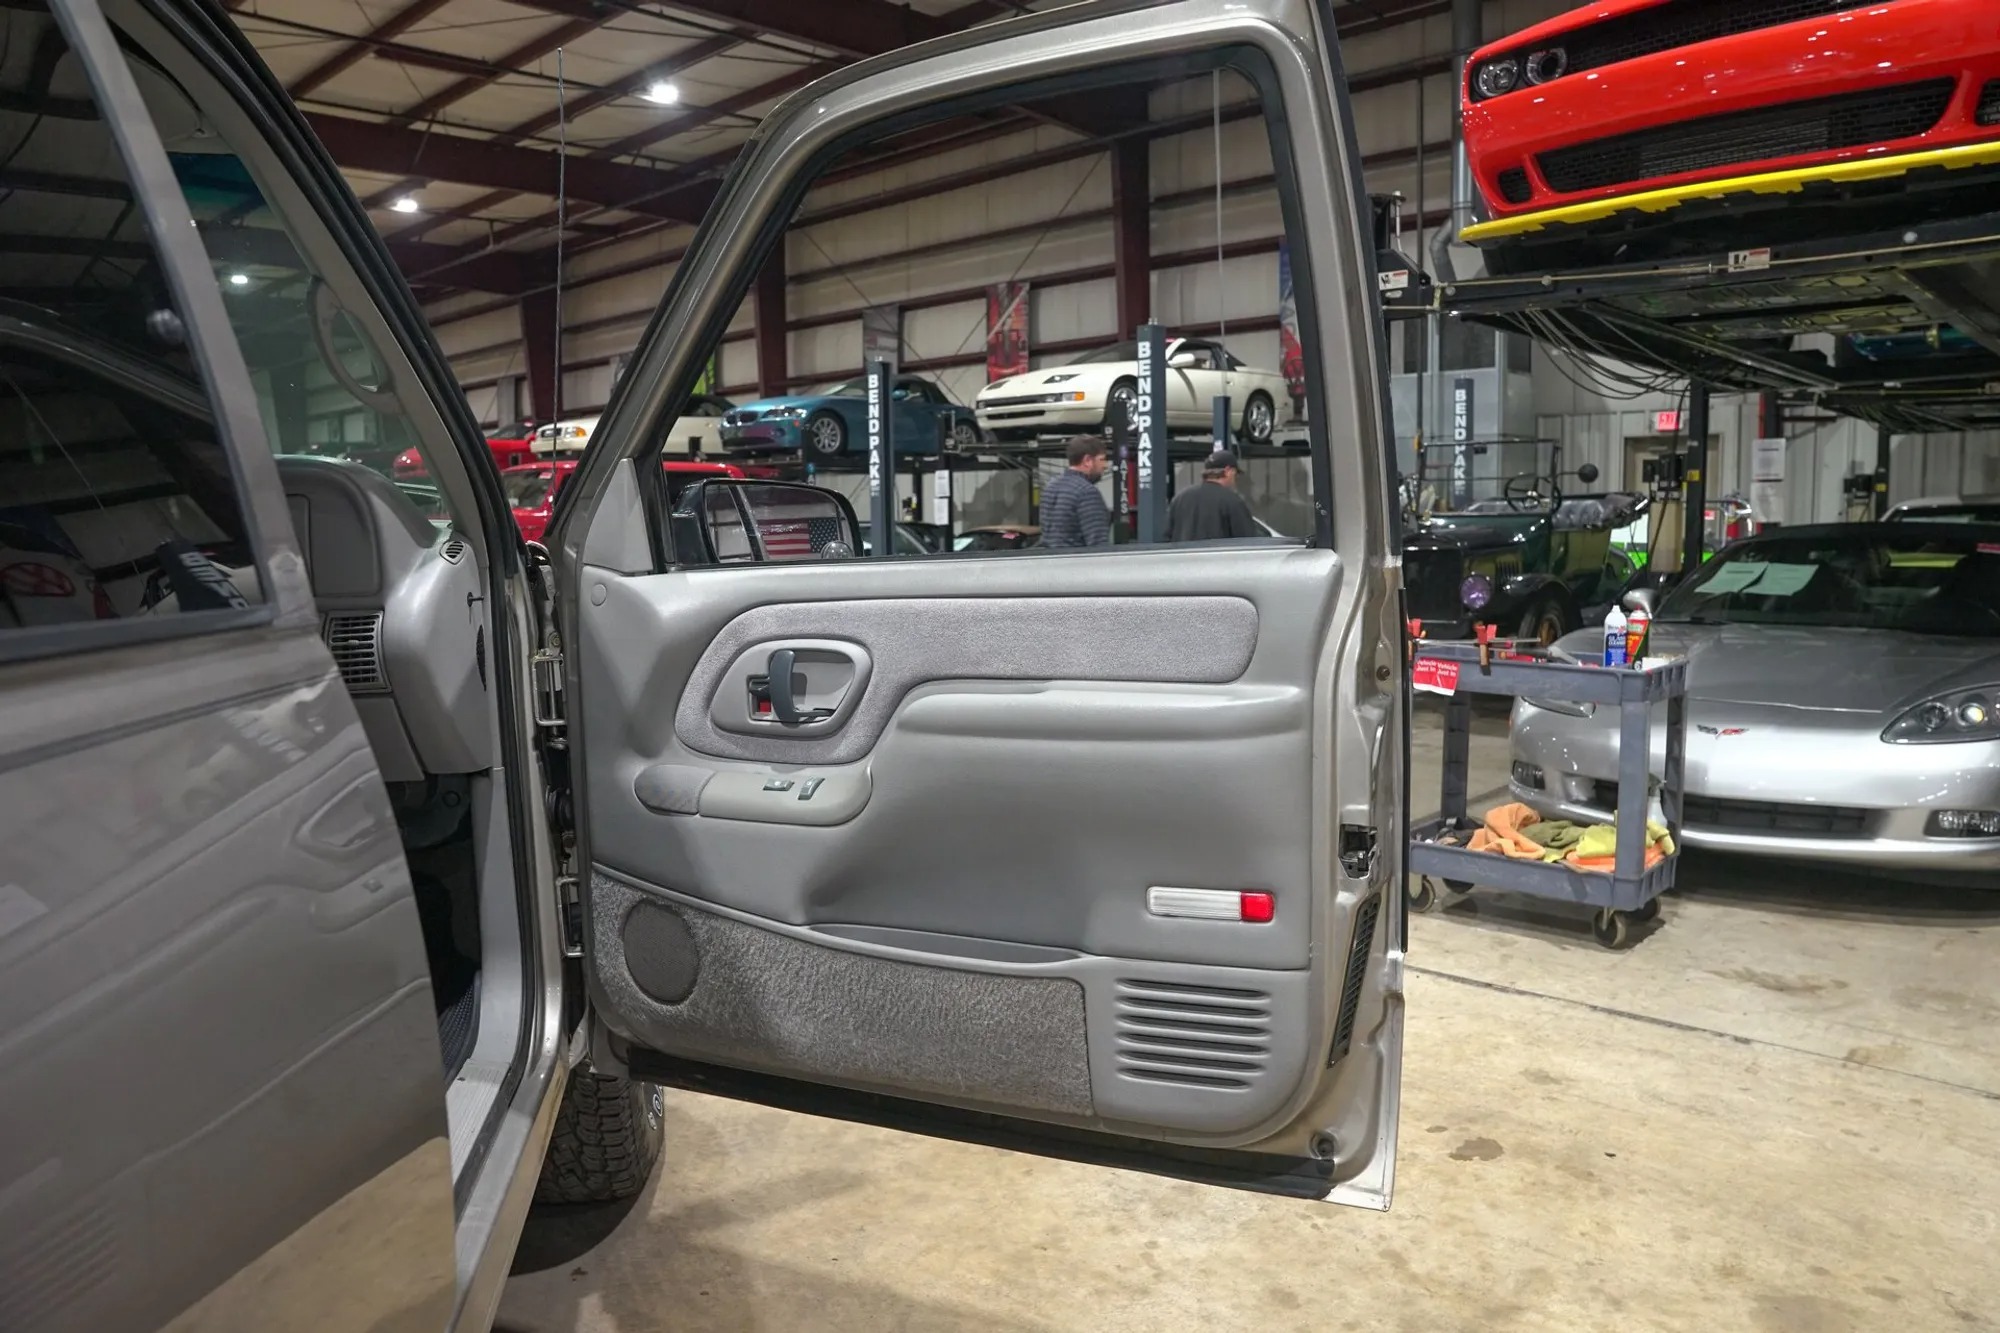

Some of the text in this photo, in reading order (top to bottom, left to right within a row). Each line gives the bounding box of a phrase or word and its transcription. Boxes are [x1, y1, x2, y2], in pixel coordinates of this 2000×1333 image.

[868, 374, 880, 478] BENDPAK
[1138, 341, 1152, 467] BENDPAK
[1120, 459, 1129, 514] ATLAS
[1437, 662, 1458, 671] Vehicle
